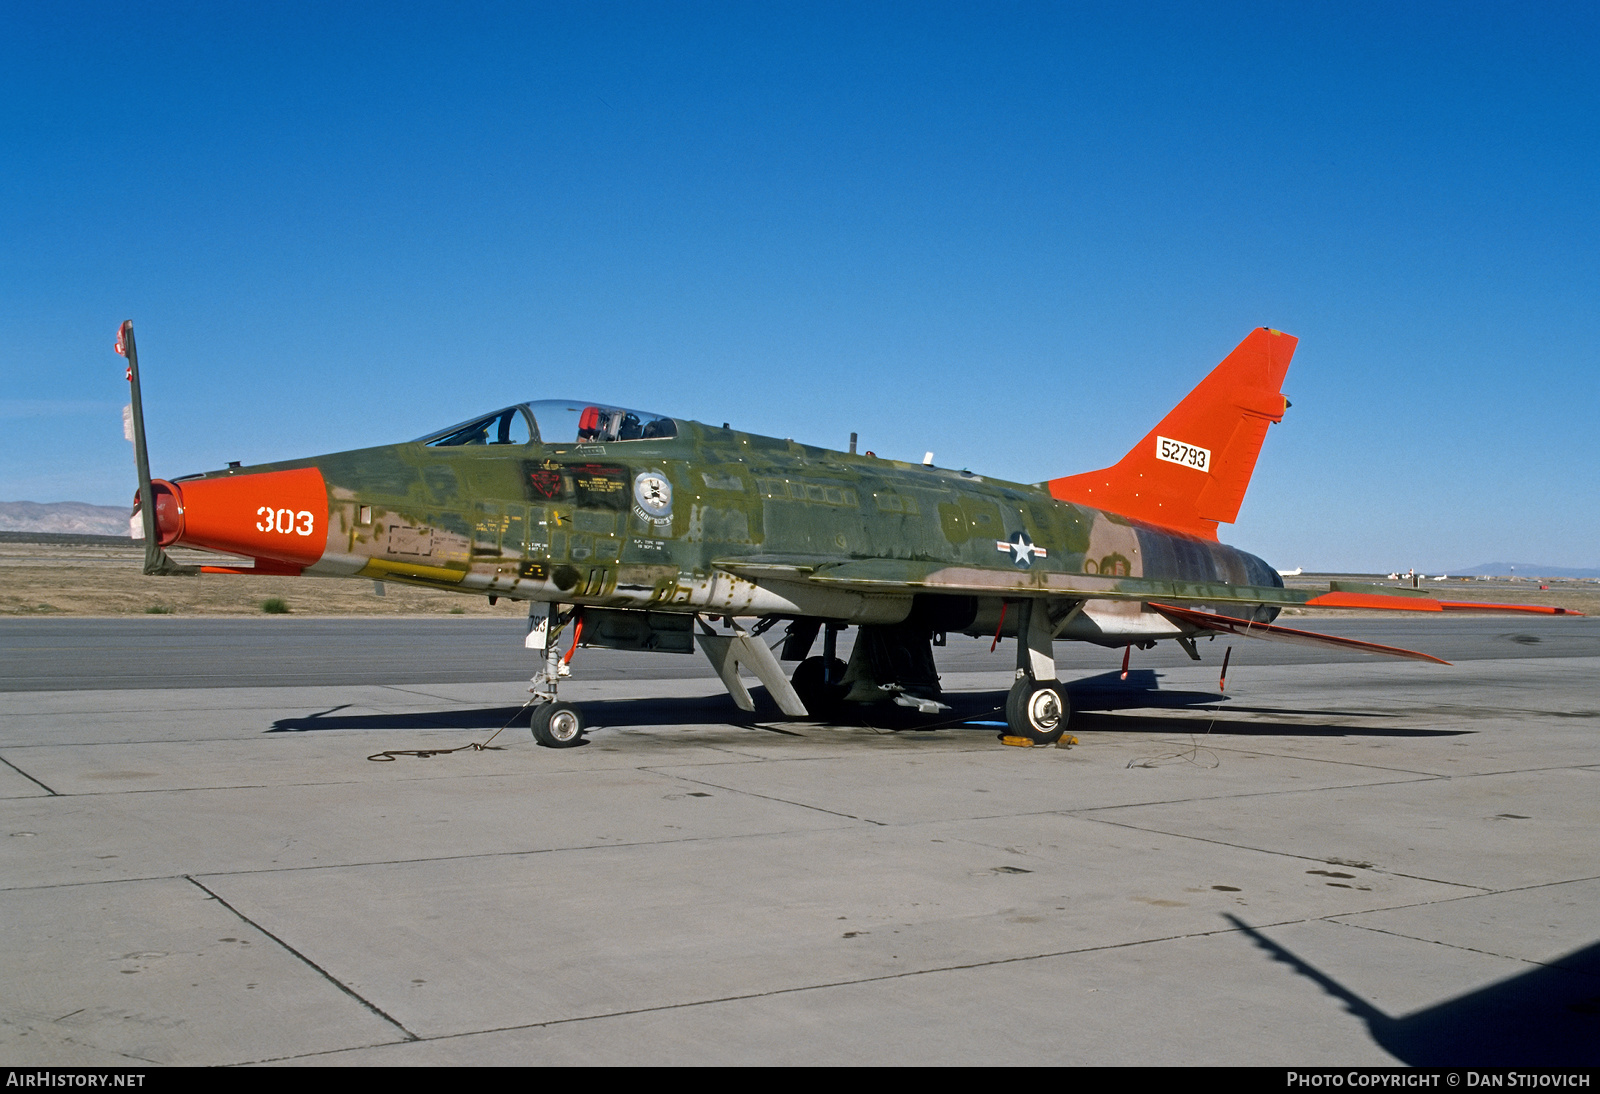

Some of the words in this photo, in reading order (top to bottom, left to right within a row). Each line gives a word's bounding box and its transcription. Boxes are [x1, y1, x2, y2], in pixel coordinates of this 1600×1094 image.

[1162, 440, 1206, 468] 52793
[256, 506, 314, 536] 303
[530, 615, 546, 632] 793
